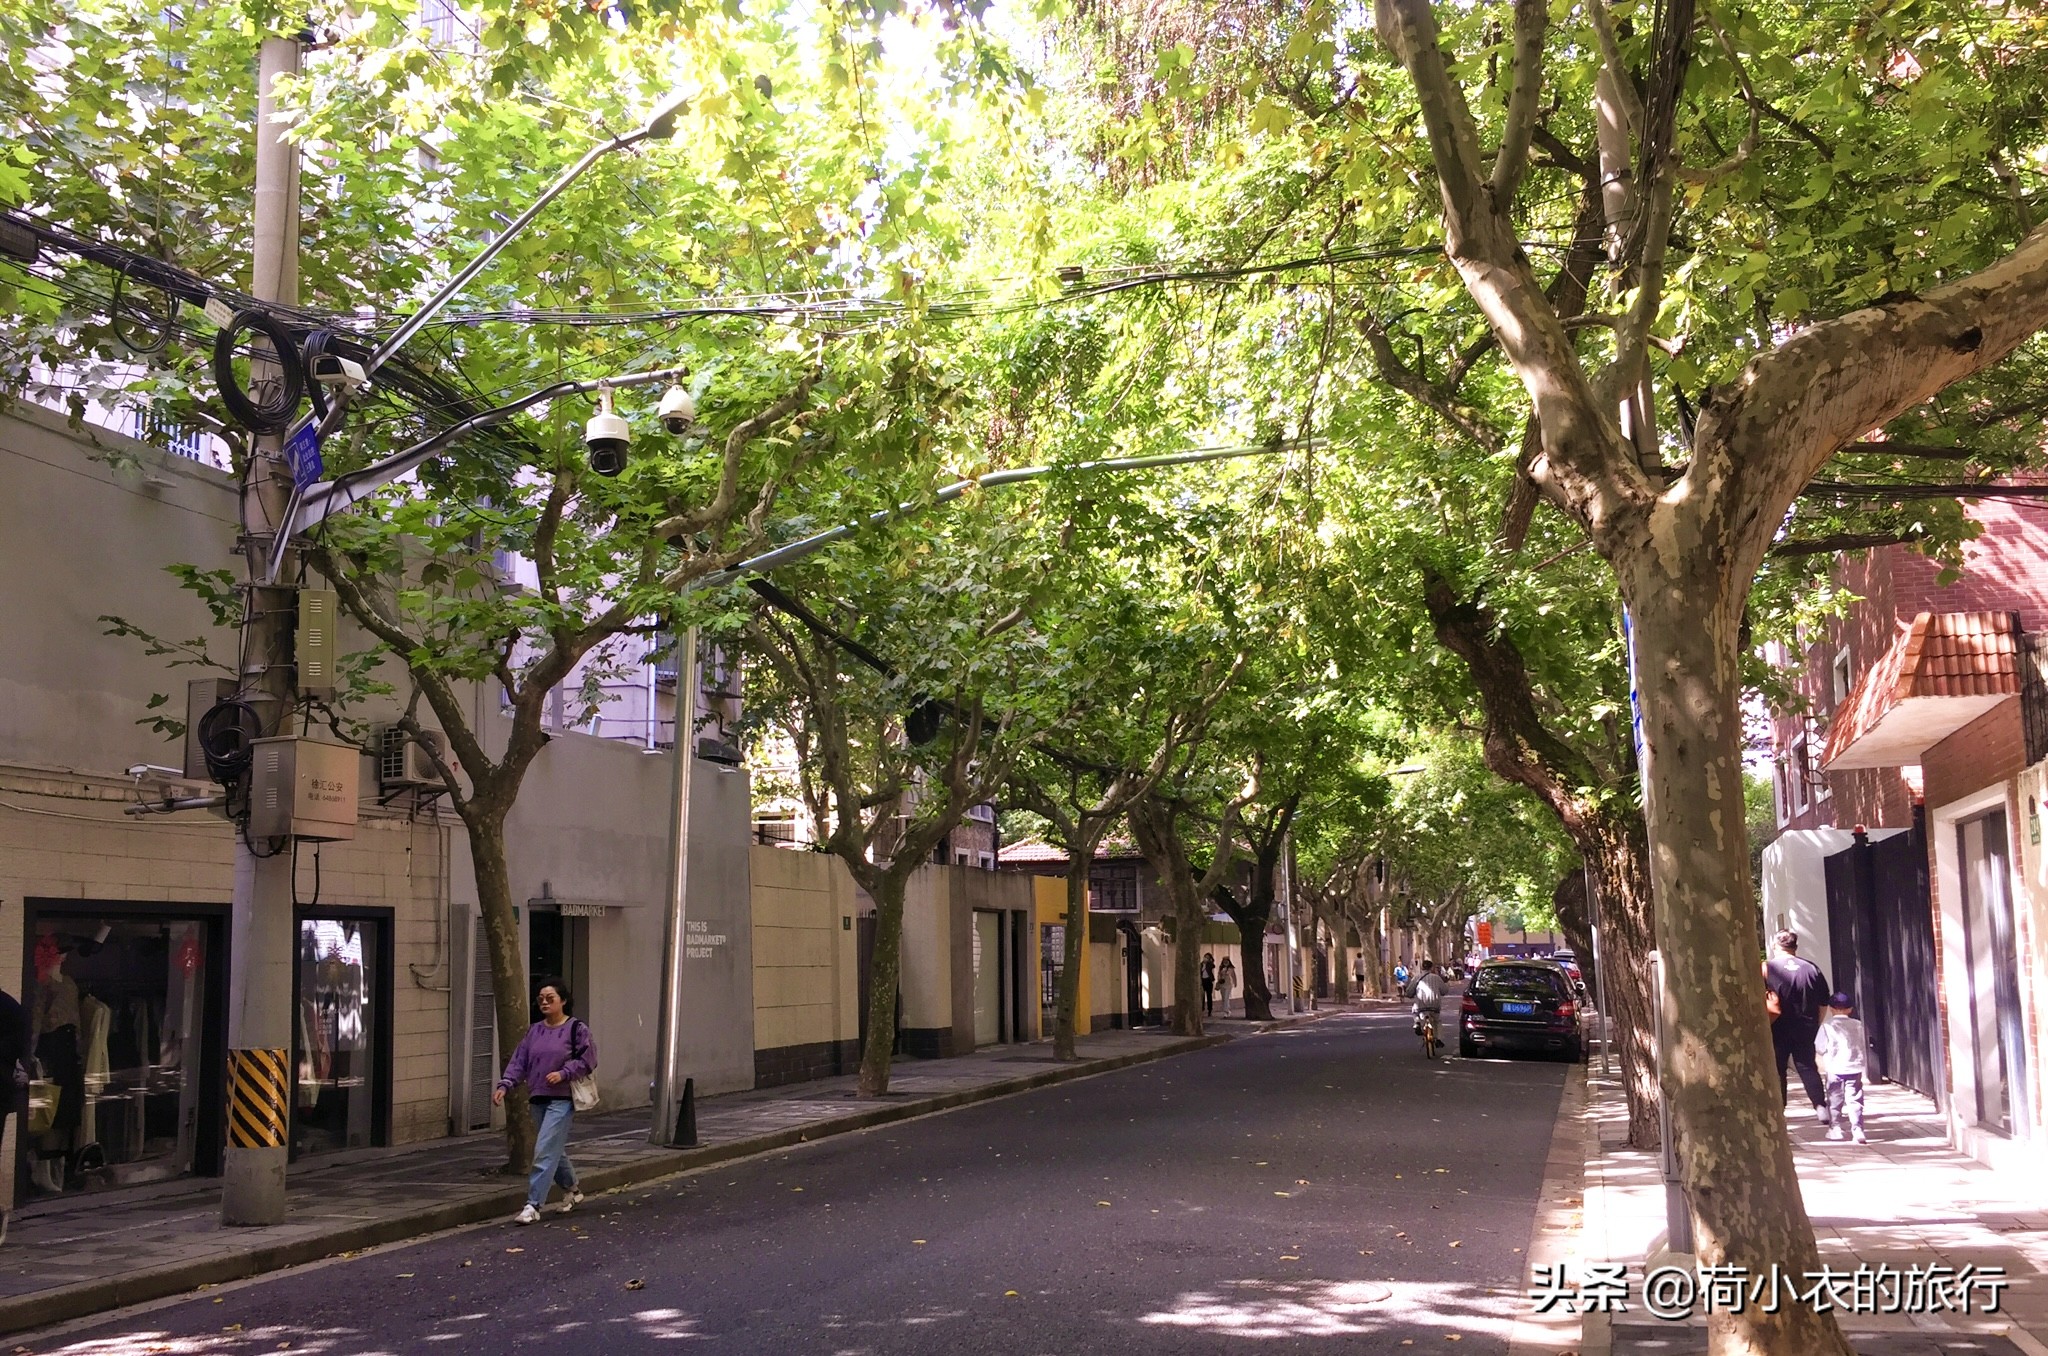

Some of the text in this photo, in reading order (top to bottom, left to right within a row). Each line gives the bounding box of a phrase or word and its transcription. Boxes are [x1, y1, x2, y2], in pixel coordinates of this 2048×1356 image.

[311, 779, 343, 792] 徐汇公安
[561, 904, 605, 917] BADMARKET
[686, 921, 708, 932] THIS IS
[686, 947, 713, 958] PROJECT
